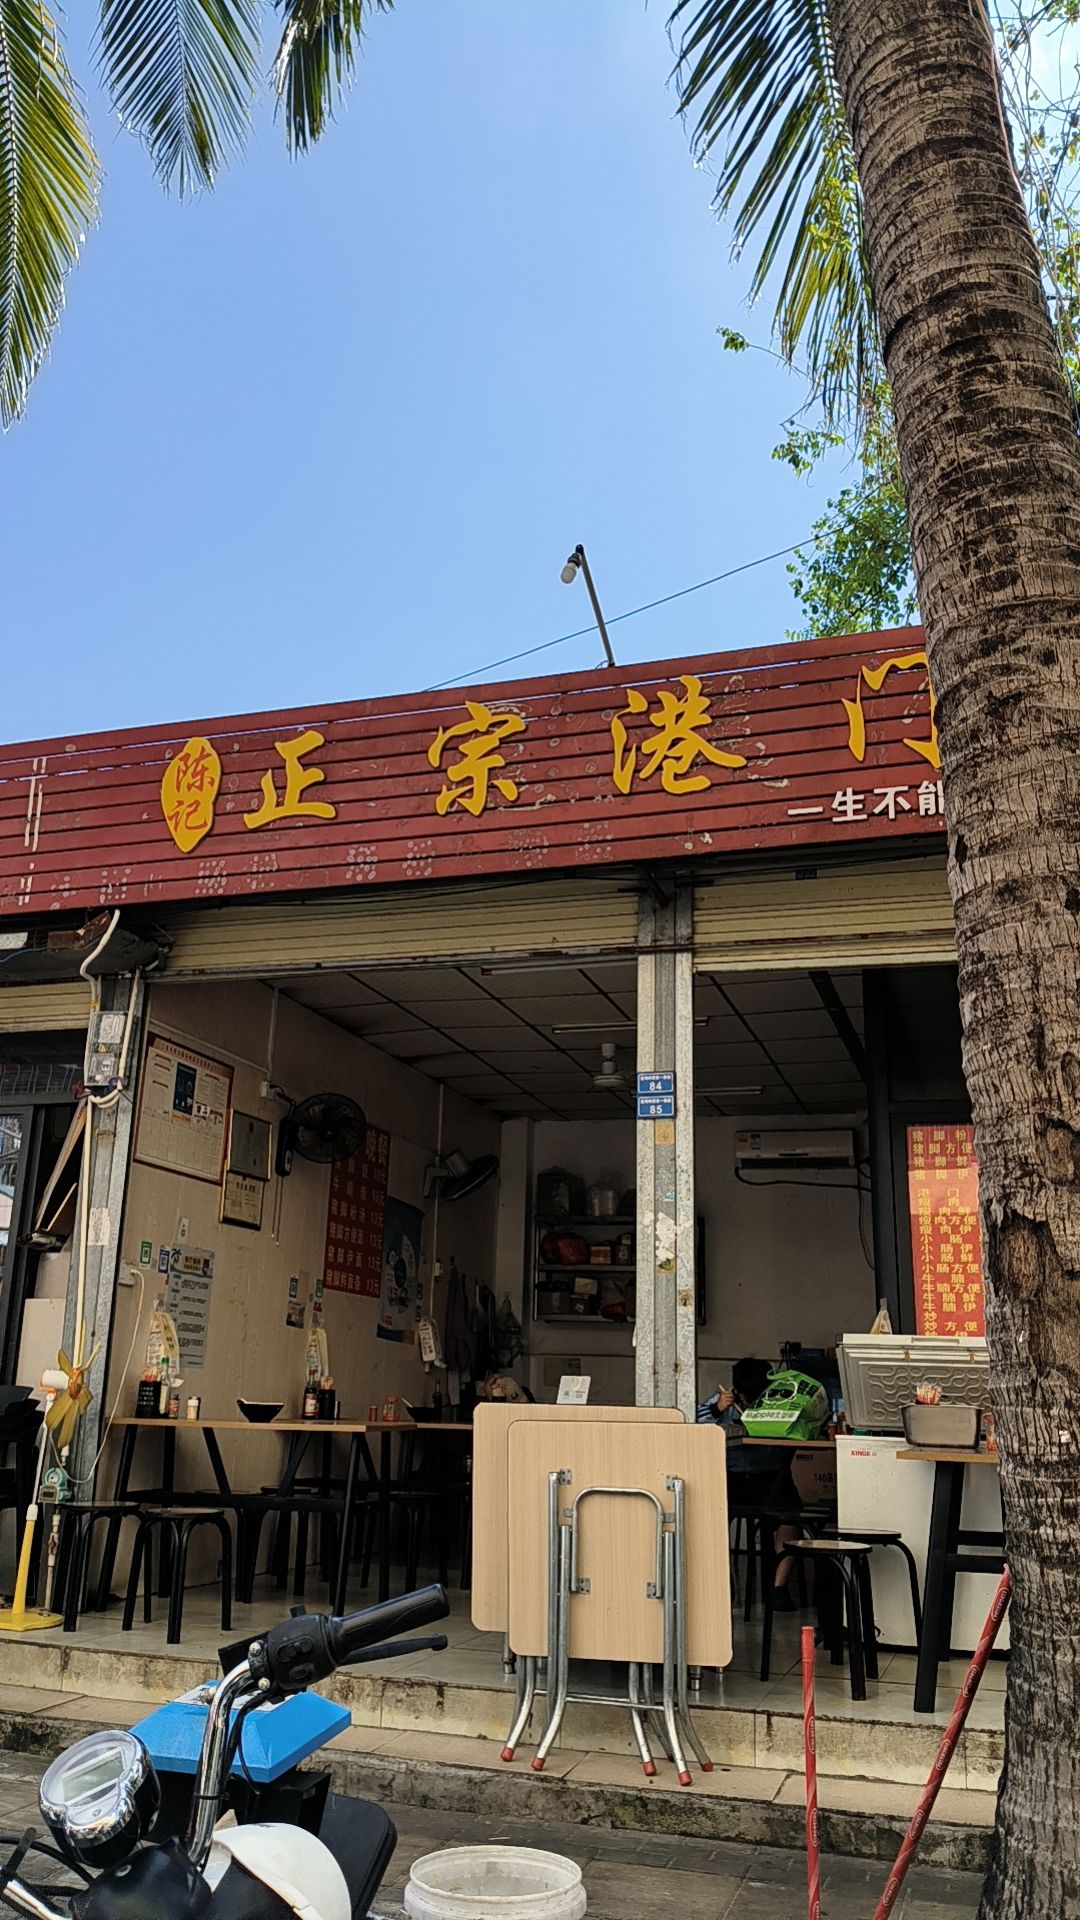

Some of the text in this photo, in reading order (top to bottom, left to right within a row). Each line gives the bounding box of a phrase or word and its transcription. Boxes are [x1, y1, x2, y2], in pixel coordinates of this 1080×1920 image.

[167, 745, 215, 833] 陈记
[787, 780, 945, 823] 一生不能
[649, 1081, 662, 1091] 84
[650, 1105, 663, 1114] 85
